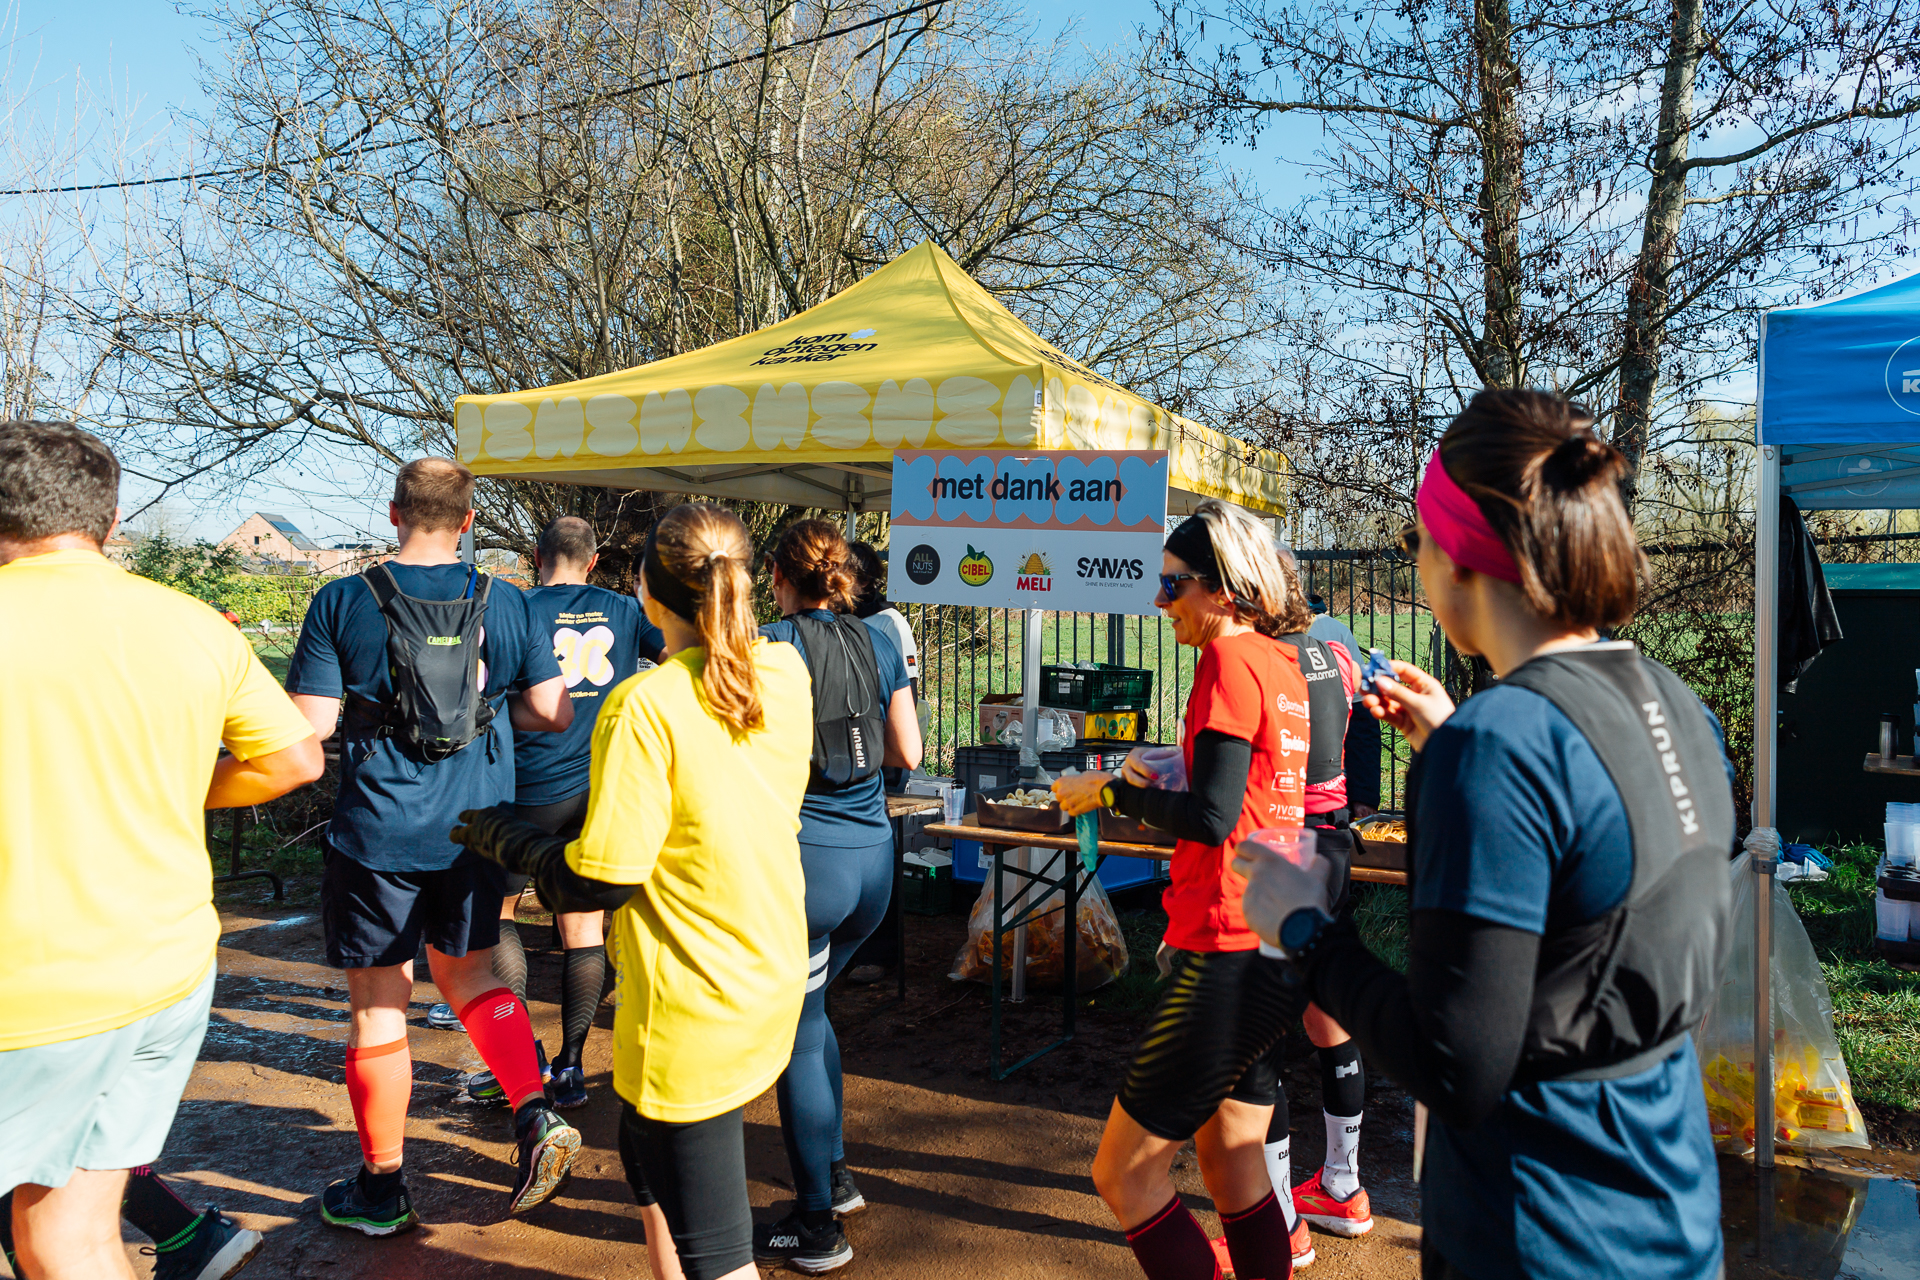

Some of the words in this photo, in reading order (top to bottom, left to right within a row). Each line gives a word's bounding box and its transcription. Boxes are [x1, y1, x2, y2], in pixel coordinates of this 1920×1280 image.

[786, 333, 848, 346] kom
[749, 353, 847, 366] kanker
[932, 473, 984, 499] met
[991, 472, 1060, 501] dank
[1069, 477, 1122, 502] aan
[912, 561, 934, 571] NUTS
[961, 564, 990, 576] CIBEL
[1076, 557, 1144, 580] SANAS
[1016, 576, 1052, 592] MELI
[851, 727, 866, 768] KIPRUN
[1642, 701, 1699, 835] KIPRUN
[768, 1235, 799, 1247] HOKA
